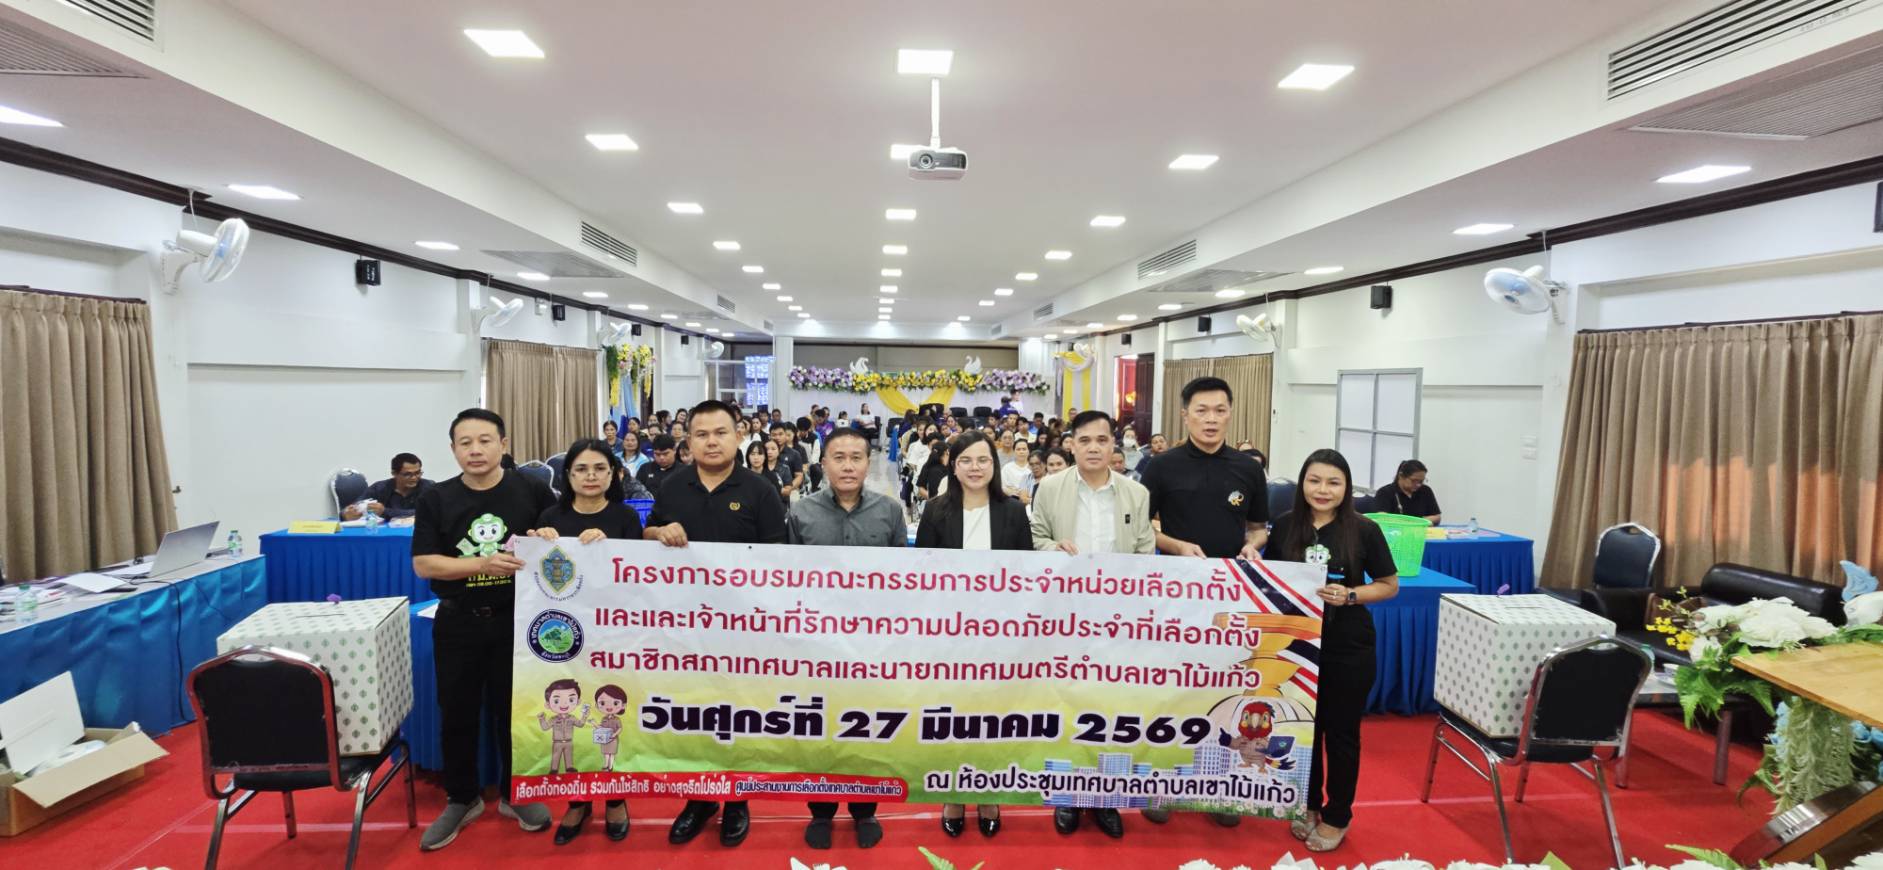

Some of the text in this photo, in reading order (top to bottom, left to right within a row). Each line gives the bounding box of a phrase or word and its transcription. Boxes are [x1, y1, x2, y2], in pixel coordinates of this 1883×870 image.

[612, 558, 1241, 601] โครงการอบรมคณะกรรมการประจำหน่วยเลือกตั้ง
[595, 602, 1261, 648] และและเจ้าหน้าที่รักษาความปลอดภัยประจำที่เลือกตั้ง
[590, 648, 1261, 689] สมาชิกสภาเทศบาลและนายกเทศมนตรีตำบลเขาไม้แก้ว
[642, 696, 1211, 745] วันศุกร์ที่ 27 มีนาคม 2569
[516, 775, 587, 800] เลือกตั้งท้องถิ่น
[926, 766, 1295, 805] ณ ห้องประชุมเทศบาลตำบลเขาไม้แก้ว
